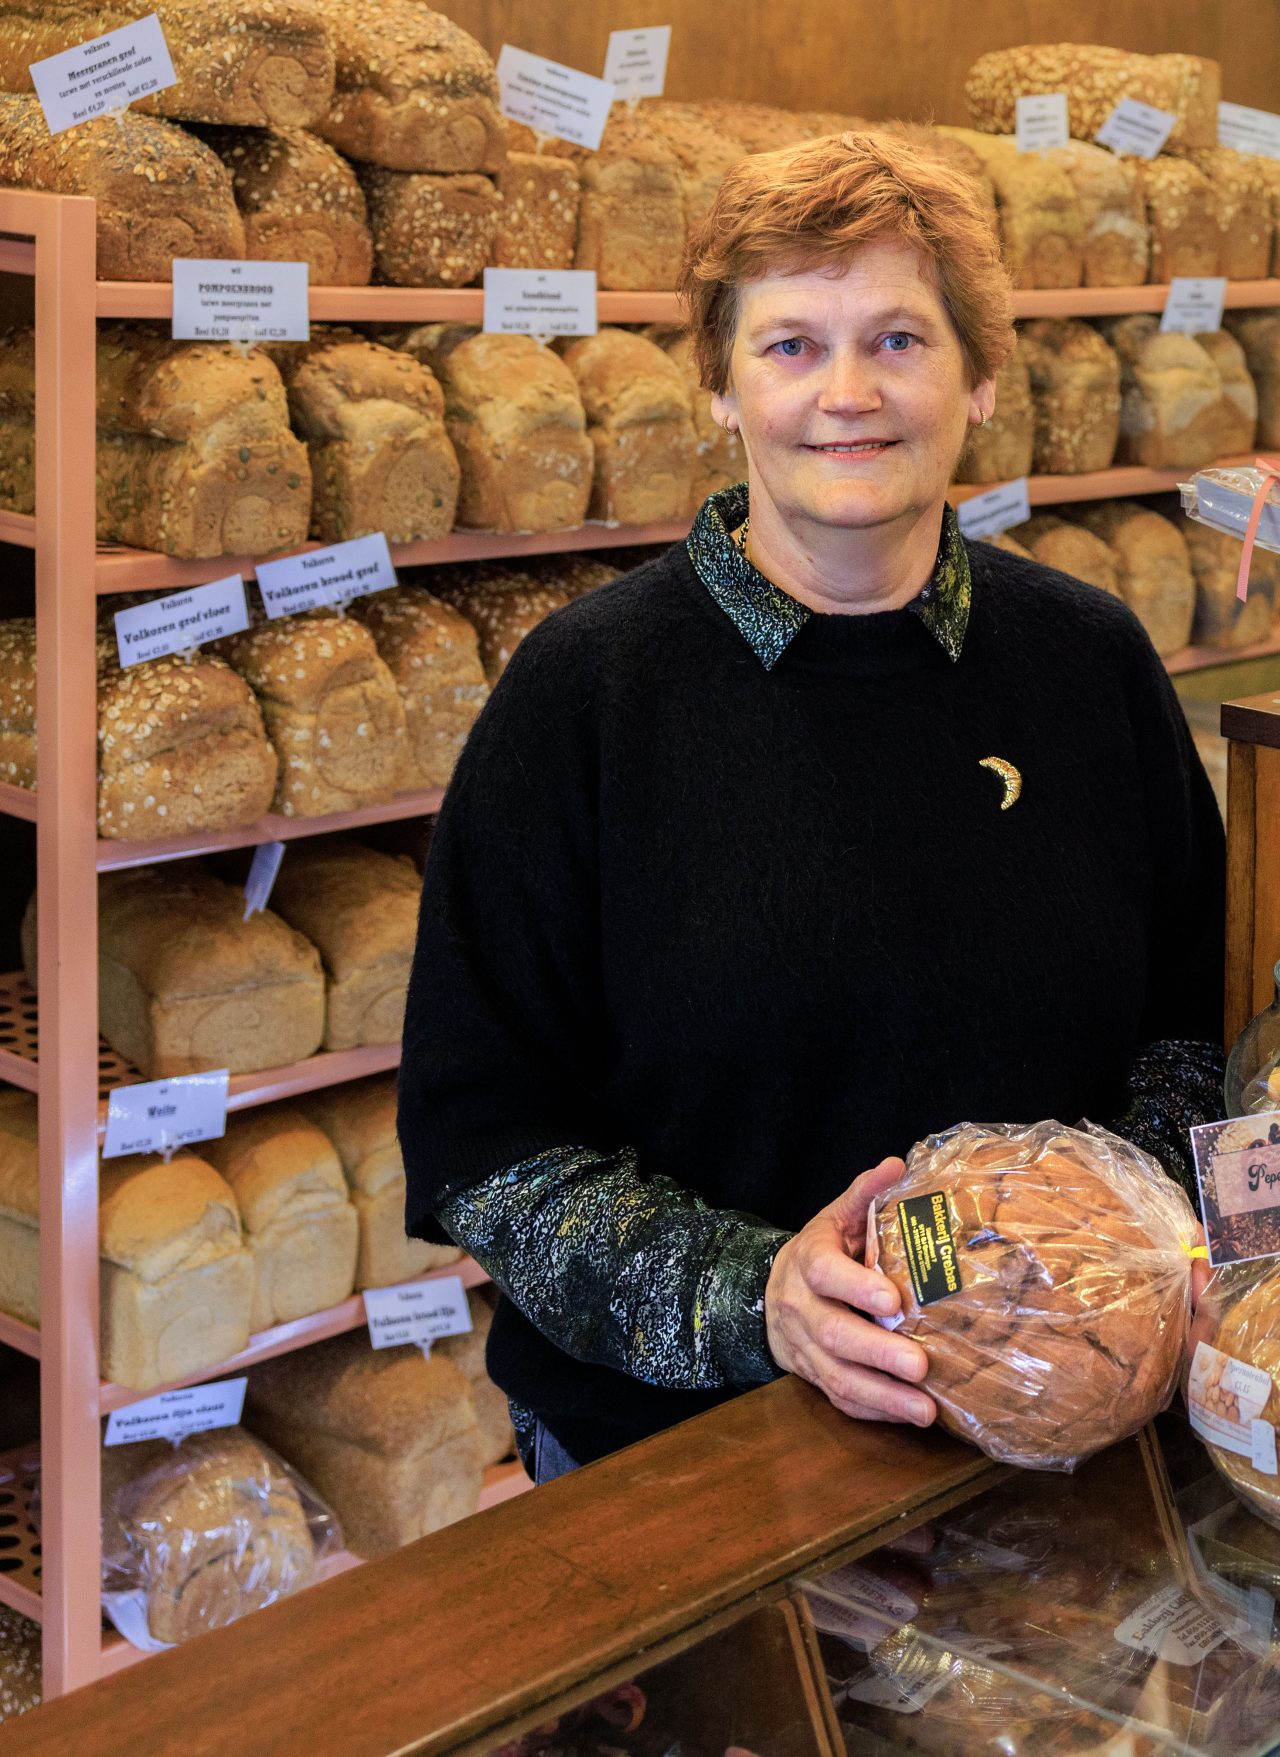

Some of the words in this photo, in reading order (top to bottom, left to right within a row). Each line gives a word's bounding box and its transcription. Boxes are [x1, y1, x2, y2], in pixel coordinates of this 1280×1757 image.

[68, 56, 118, 81] Meergranen
[119, 46, 136, 62] grof
[265, 581, 319, 600] Volkoren
[320, 569, 354, 587] brood
[355, 562, 379, 579] grof
[123, 621, 177, 645] Volkoren
[177, 612, 202, 630] grof
[202, 604, 231, 620] vloer
[931, 1195, 951, 1245] Bakkerij
[940, 1244, 958, 1293] Crebas
